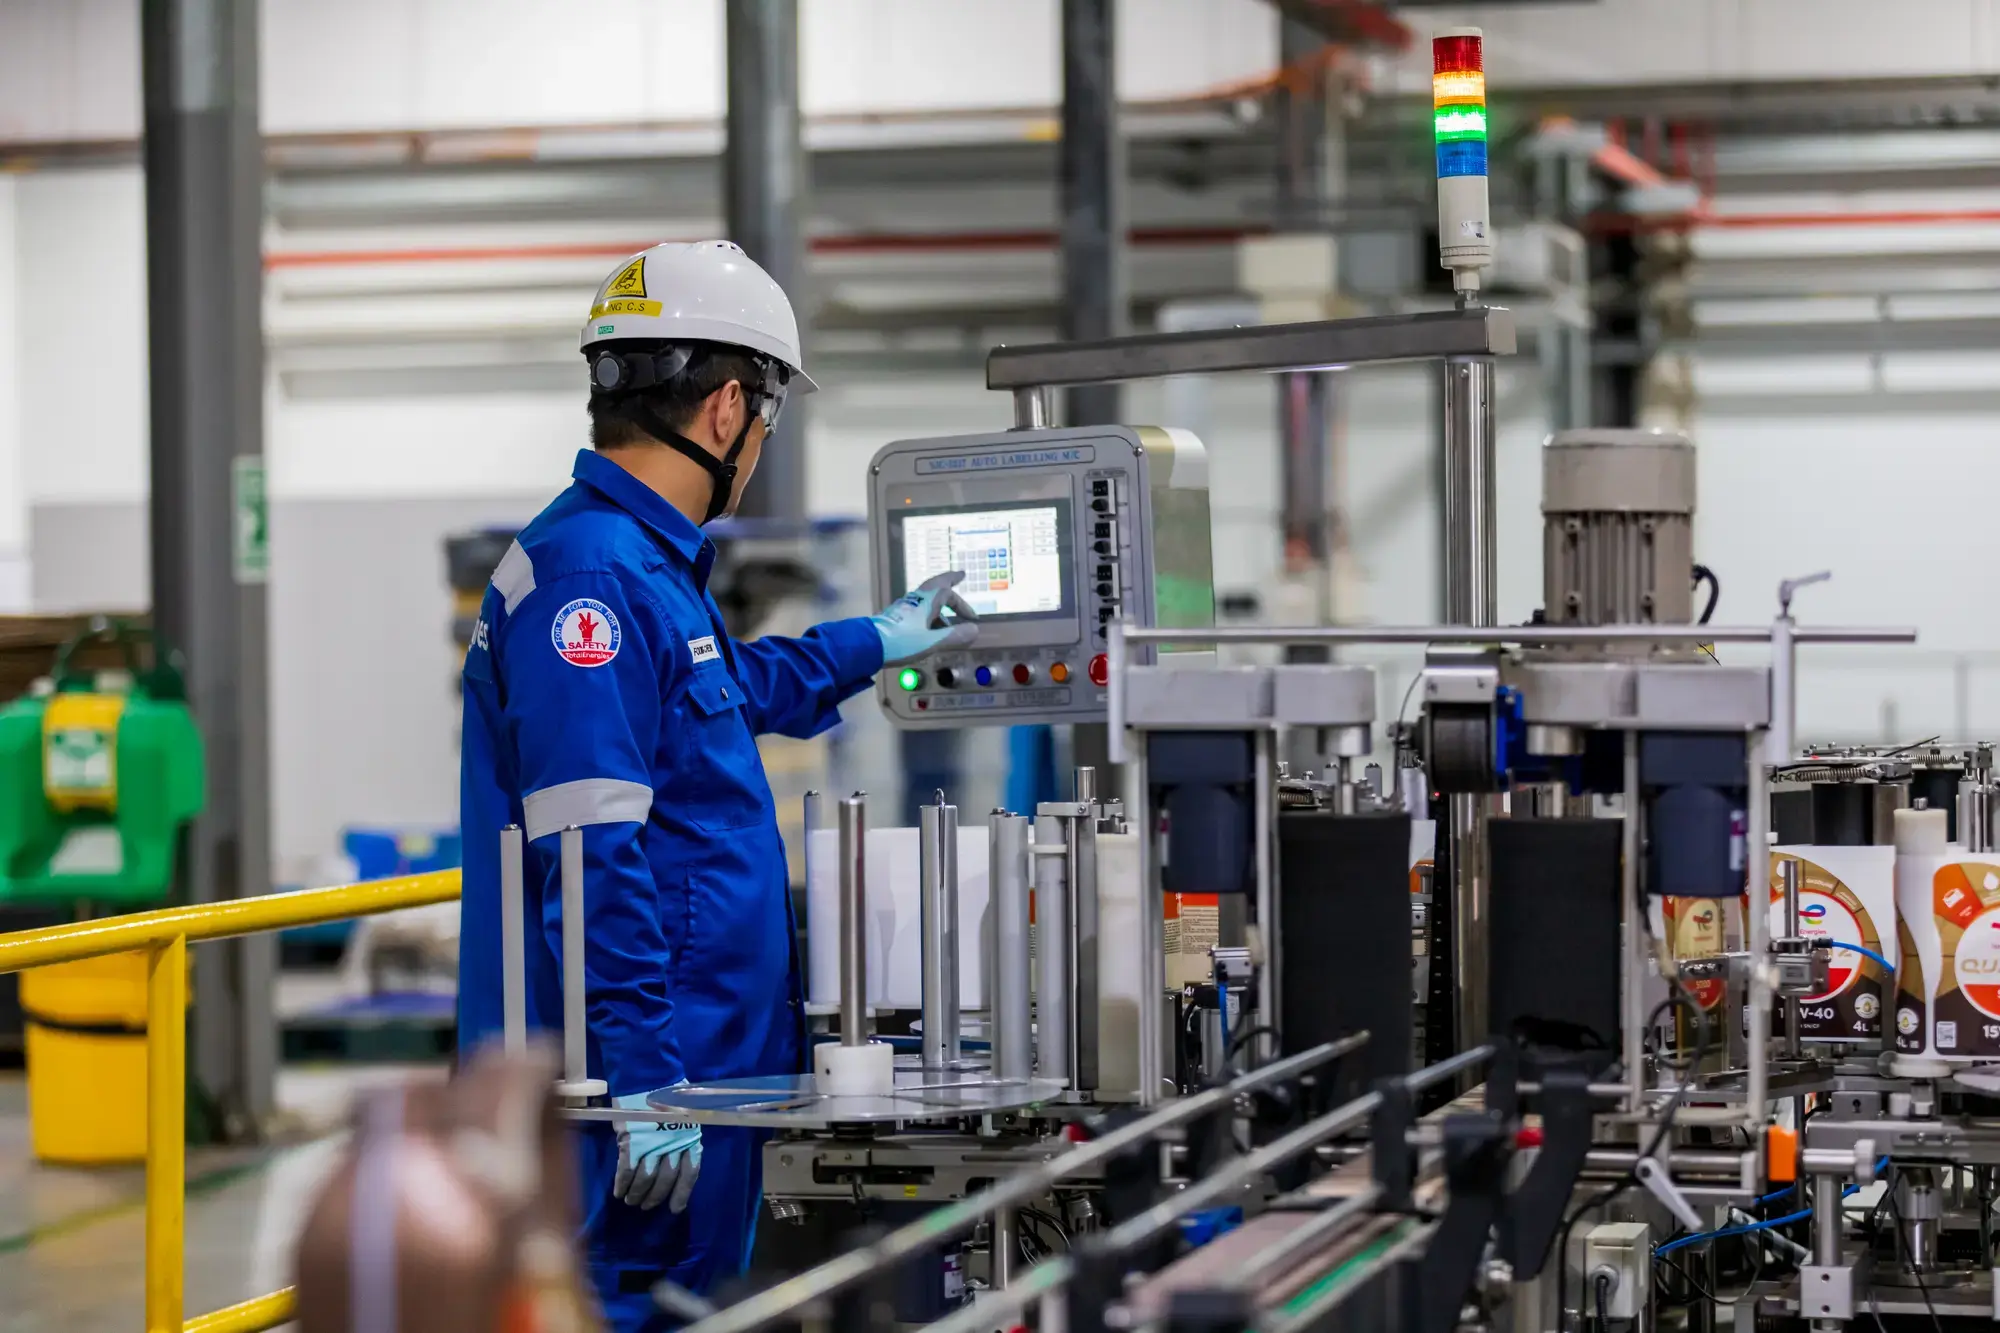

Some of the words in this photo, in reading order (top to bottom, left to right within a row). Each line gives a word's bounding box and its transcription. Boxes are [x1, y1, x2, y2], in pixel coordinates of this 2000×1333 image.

[971, 457, 998, 468] AUTO
[1002, 451, 1058, 465] LABELLING
[568, 602, 584, 612] FOR
[605, 611, 617, 627] FOR
[568, 641, 608, 650] SAFETY
[565, 652, 610, 660] TotalEnergies
[1961, 958, 2000, 974] QU
[1852, 1020, 1869, 1032] 4L
[1982, 1025, 2000, 1039] 15
